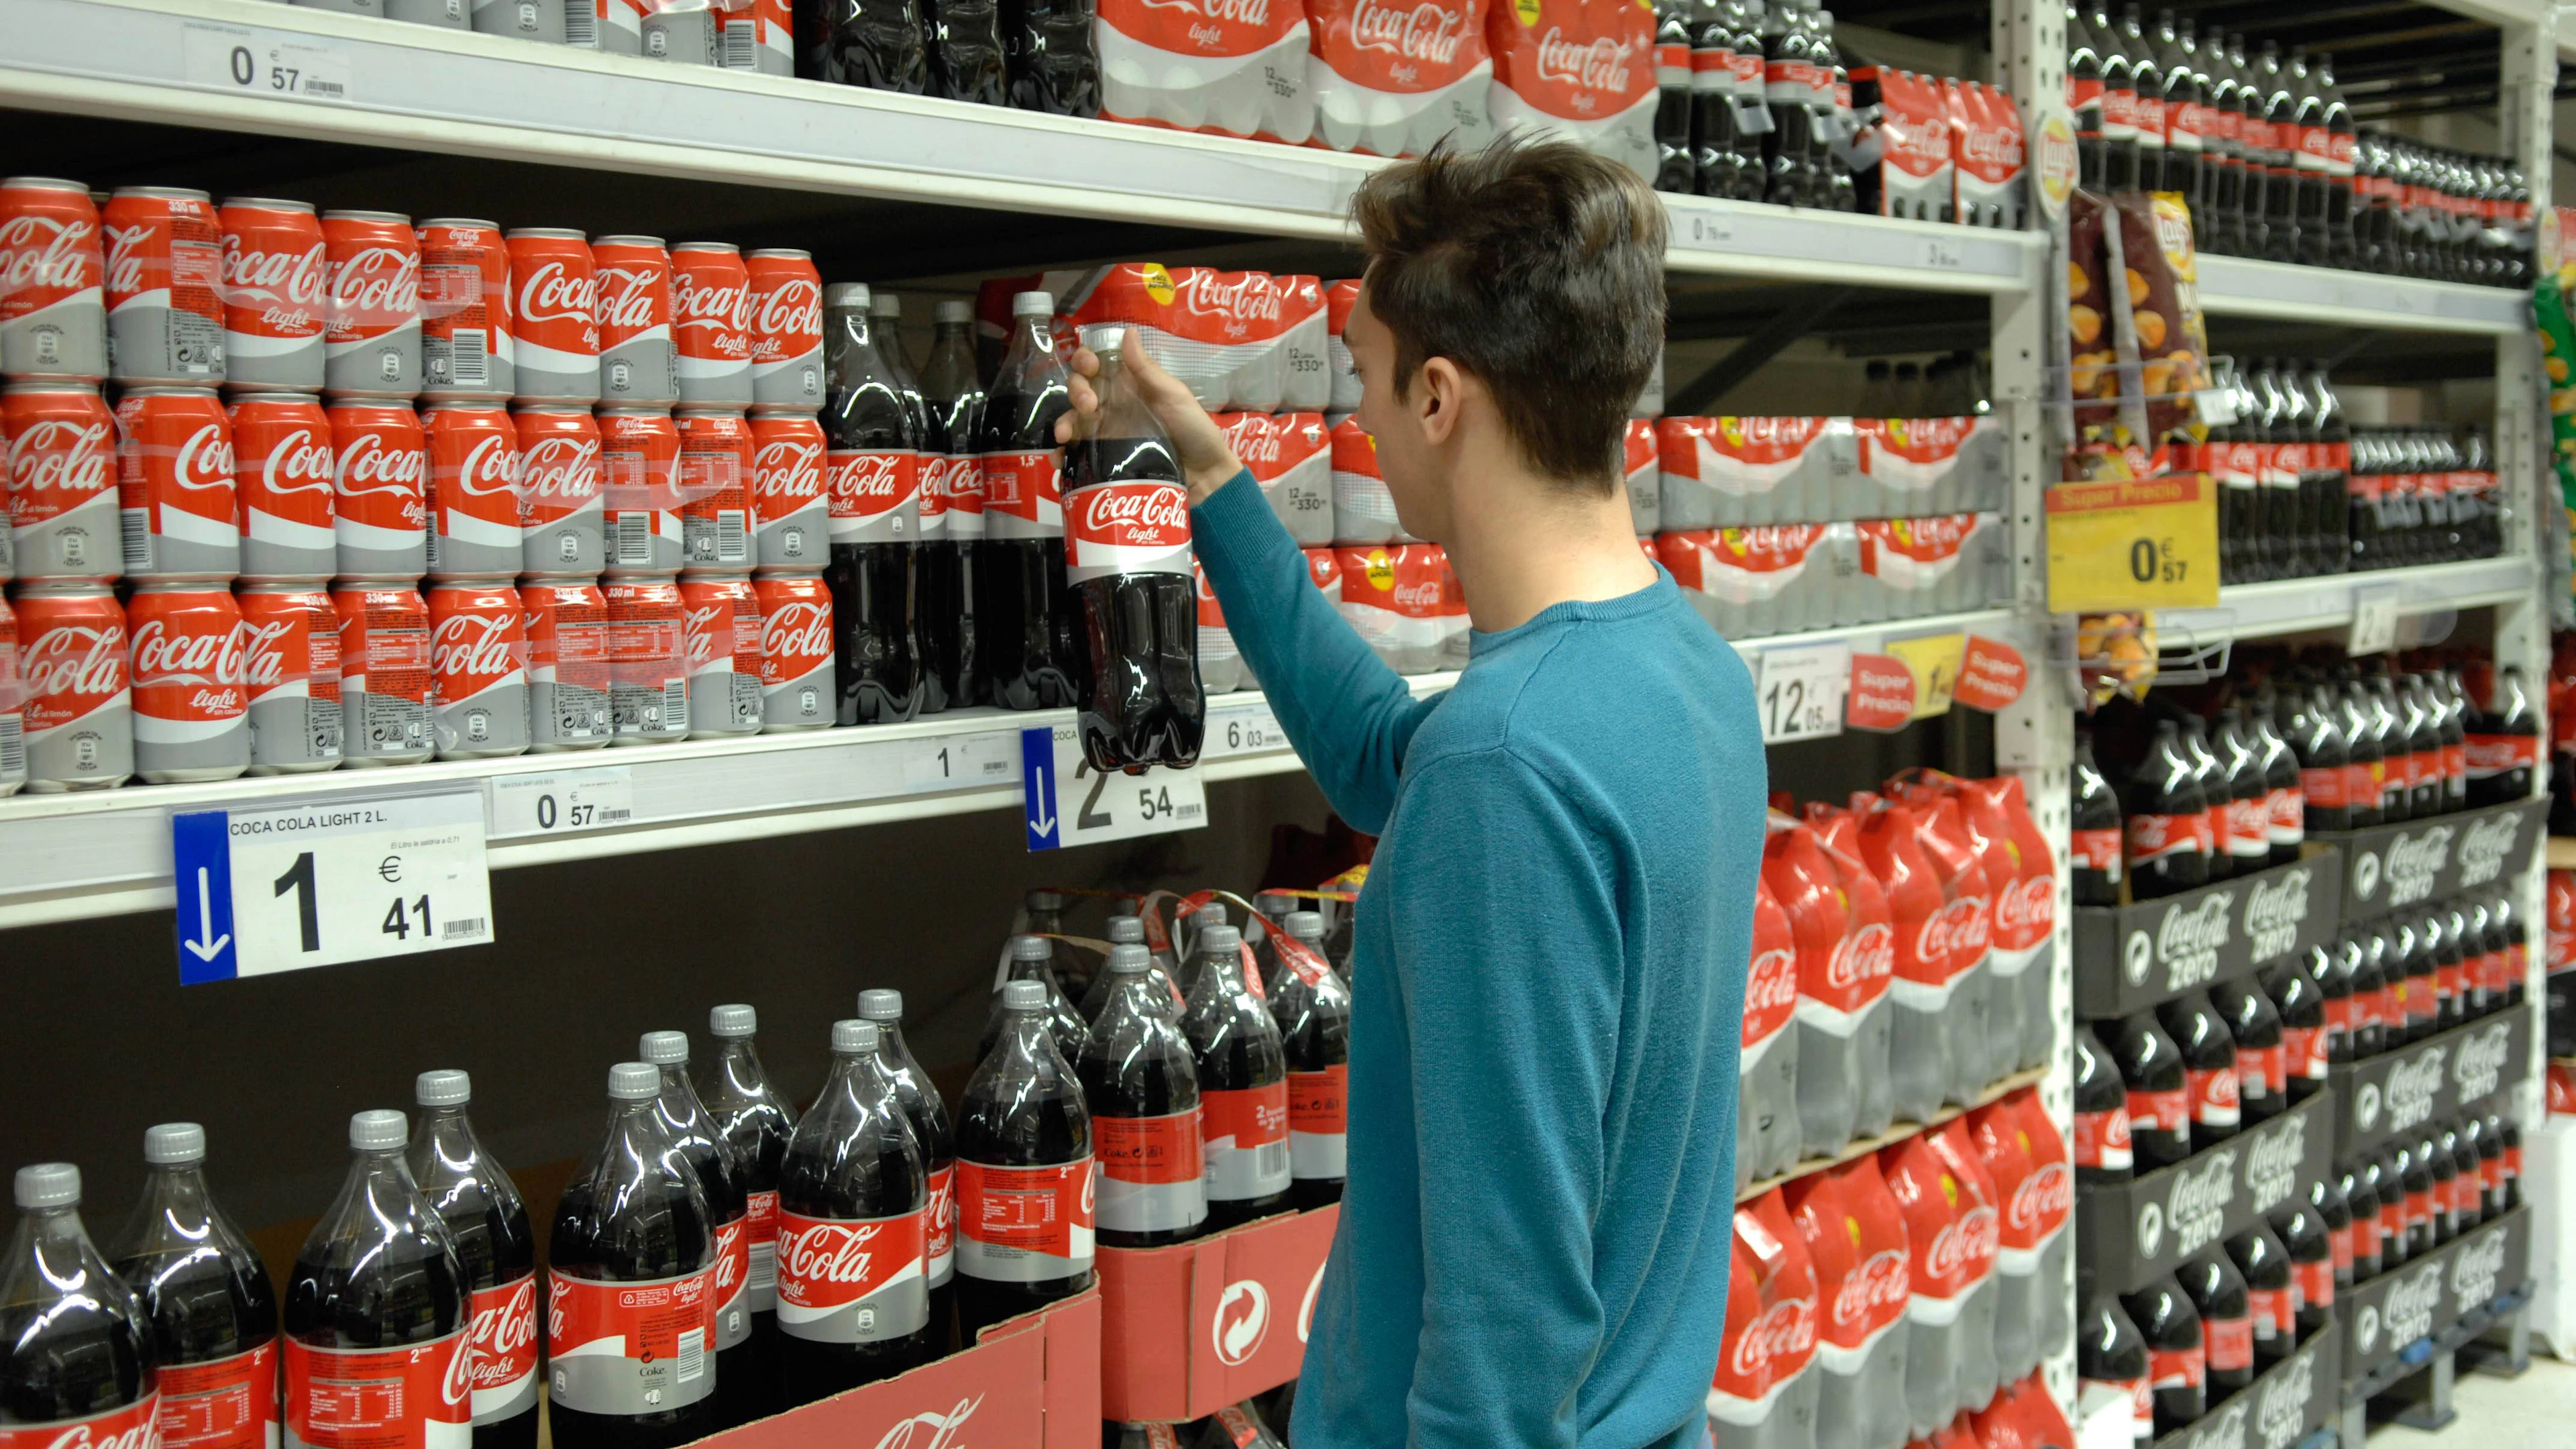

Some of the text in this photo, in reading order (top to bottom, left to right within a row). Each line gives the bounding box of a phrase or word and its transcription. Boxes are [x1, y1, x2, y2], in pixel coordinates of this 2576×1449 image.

[1188, 22, 1222, 46] light
[231, 46, 254, 85] 0
[272, 67, 299, 91] 57
[260, 306, 309, 329] light
[1289, 348, 1299, 358] 12
[1297, 359, 1320, 371] 330
[1289, 488, 1299, 498] 12
[1297, 498, 1321, 511] 330
[1087, 486, 1187, 530] Coca-Cola
[1127, 527, 1159, 542] light
[2131, 537, 2157, 582] 0
[2163, 561, 2188, 583] 57
[608, 588, 635, 597] 330 ml
[1970, 651, 2023, 677] Super
[1859, 669, 1911, 690] Super
[1964, 672, 2019, 698] Precio
[189, 688, 238, 713] light
[1766, 679, 1803, 735] 12
[1858, 693, 1913, 712] Precio
[1053, 730, 1077, 741] COCA
[1228, 721, 1262, 748] 6 03
[938, 747, 949, 777] 1
[1075, 757, 1173, 830] 2 54
[538, 794, 556, 828] 0
[571, 804, 594, 826] 57
[230, 810, 388, 836] COCA COLA LIGHT 2 L.
[274, 851, 432, 953] 1 € 41
[1060, 1167, 1067, 1179] 2
[673, 1275, 704, 1297] Coca-Cola
[254, 1350, 261, 1366] 2
[410, 1348, 420, 1364] 2
